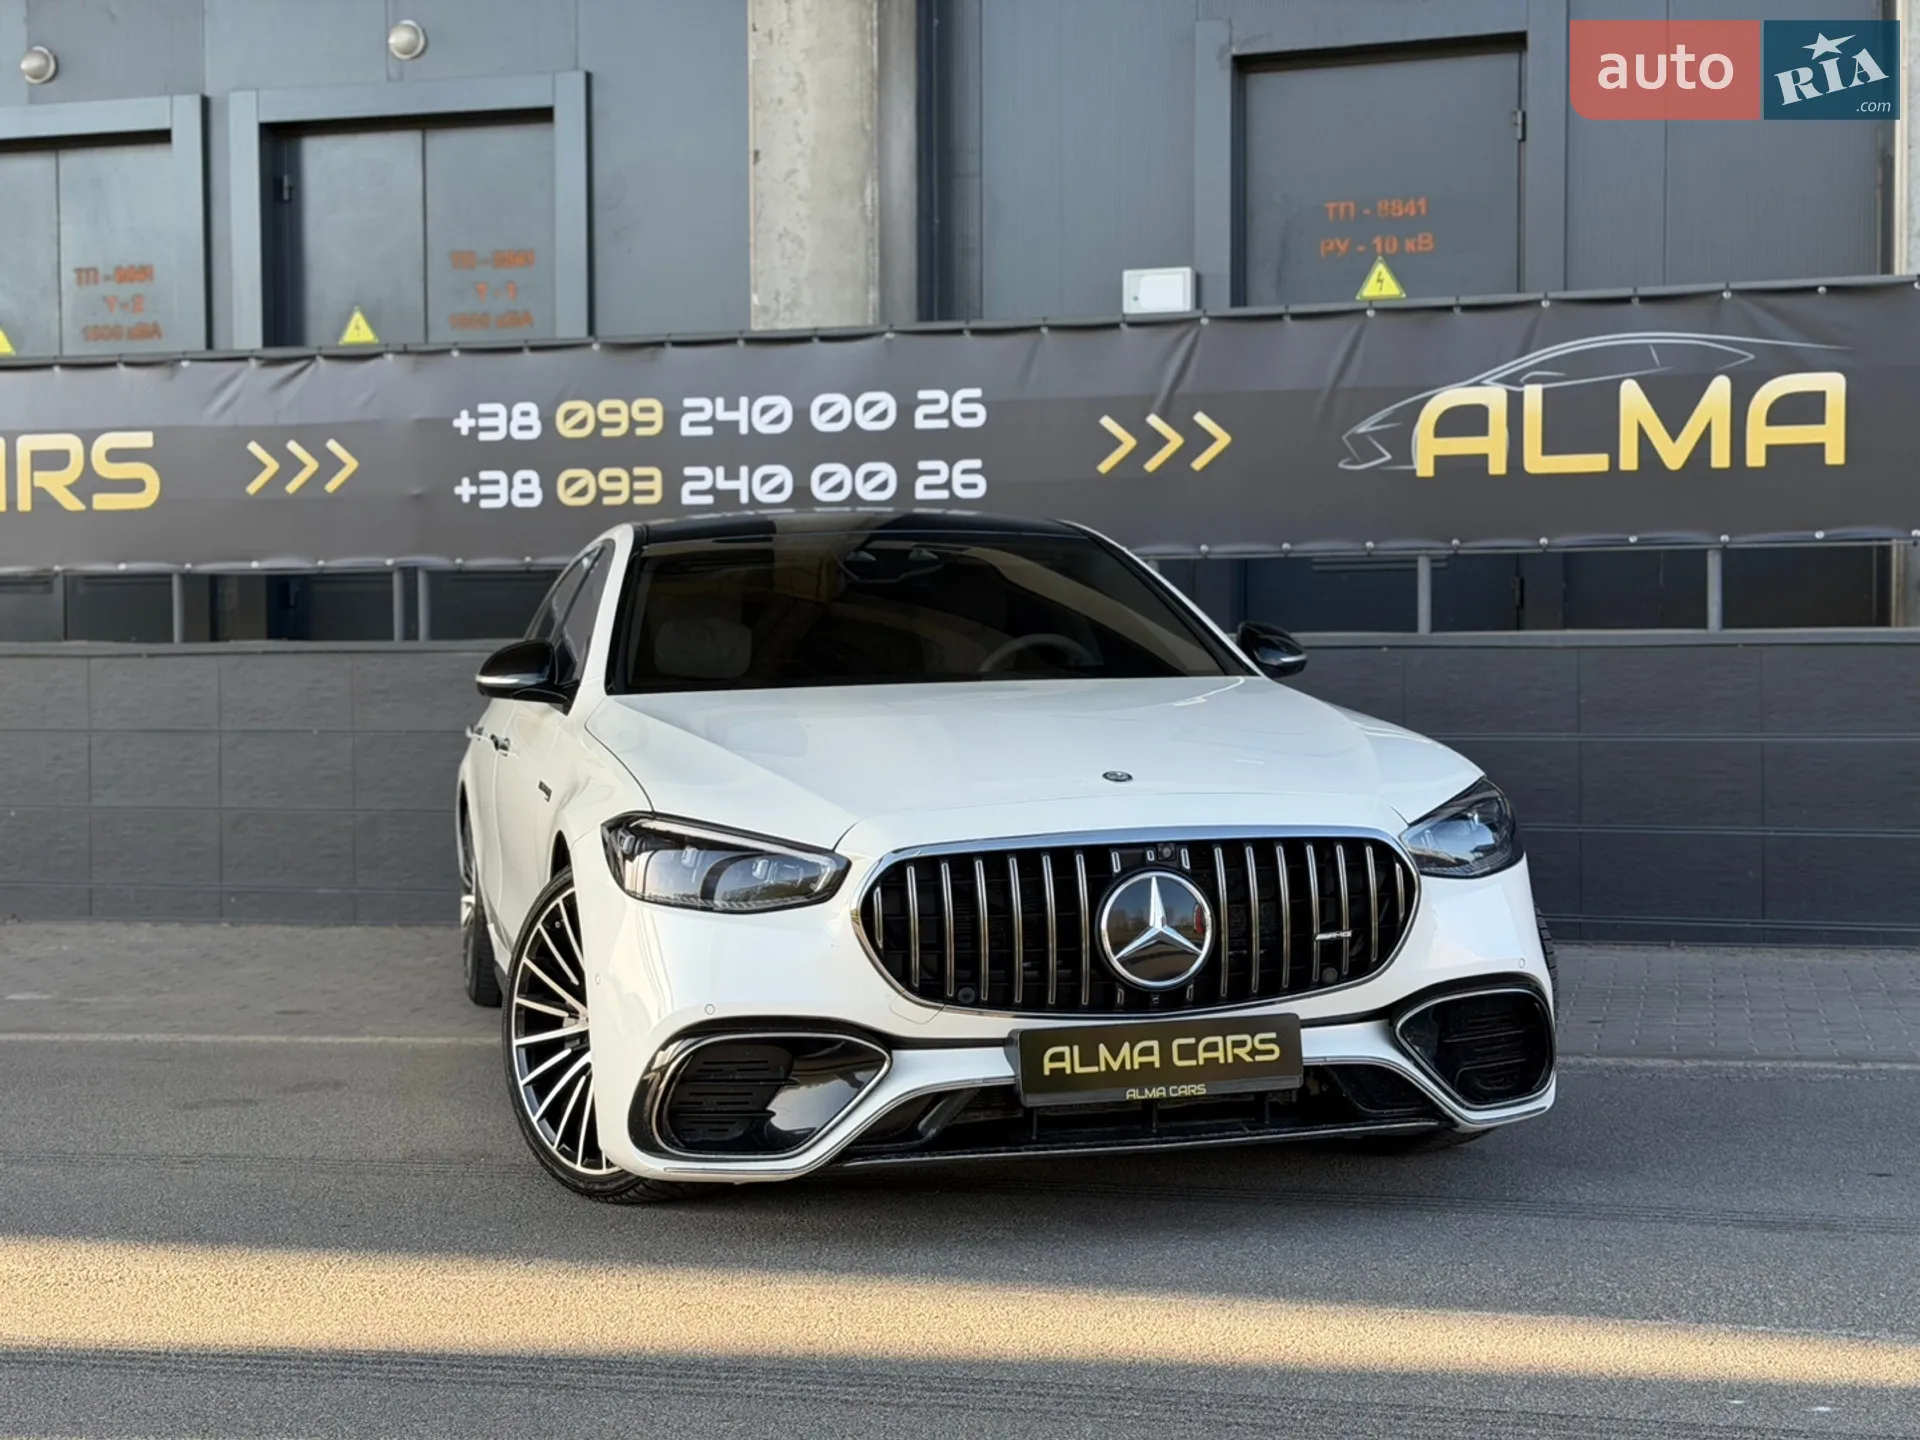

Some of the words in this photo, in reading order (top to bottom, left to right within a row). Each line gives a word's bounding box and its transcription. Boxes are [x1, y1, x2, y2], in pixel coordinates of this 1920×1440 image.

[1324, 201, 1355, 221] ТП
[1371, 235, 1398, 255] 10
[453, 402, 542, 441] +38
[555, 398, 664, 439] 099
[680, 395, 794, 437] 240
[810, 391, 898, 432] 00
[914, 388, 987, 430] 26
[1416, 371, 1846, 477] ALMA
[0, 431, 160, 513] RS
[454, 470, 543, 508] +38
[556, 467, 663, 506] 093
[681, 464, 793, 505] 240
[810, 462, 898, 502] 00
[914, 459, 988, 500] 26
[1043, 1039, 1160, 1076] ALMA
[1171, 1032, 1281, 1067] CARS
[1125, 1086, 1166, 1100] ALMA
[1169, 1083, 1207, 1098] CARS
